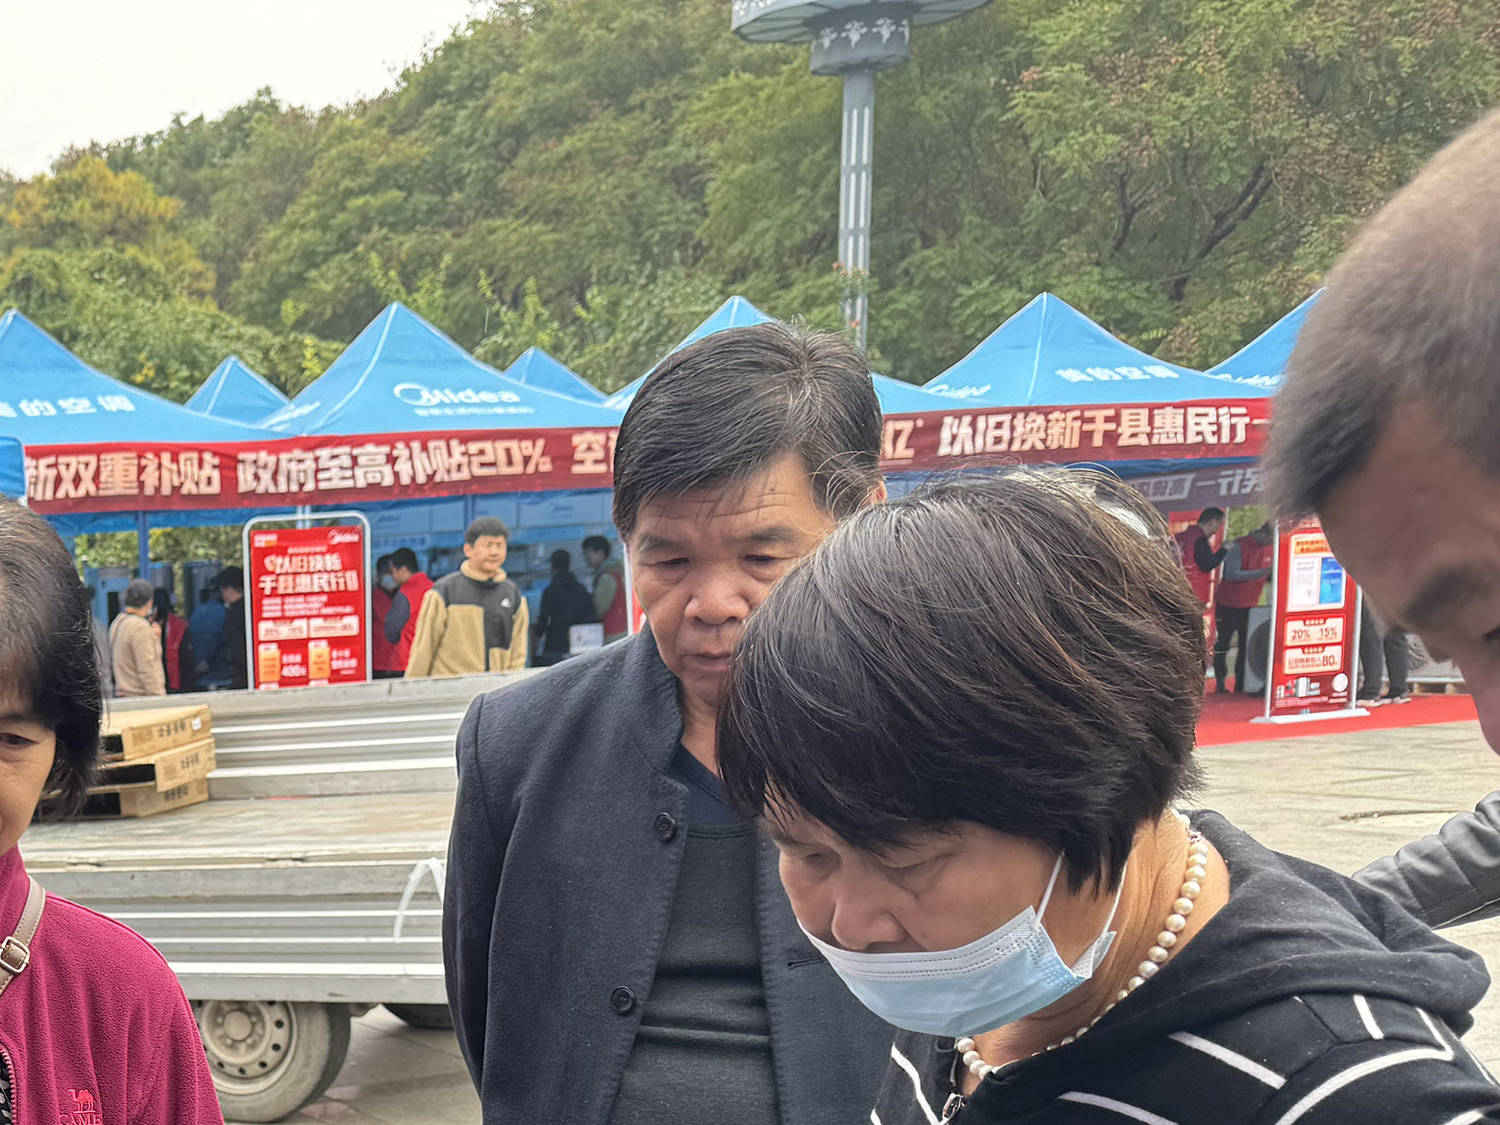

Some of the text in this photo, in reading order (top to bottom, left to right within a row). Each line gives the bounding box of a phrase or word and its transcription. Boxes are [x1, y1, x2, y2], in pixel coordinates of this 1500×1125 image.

[393, 383, 521, 407] Midea
[237, 437, 552, 495] 政府至高补贴20%
[571, 431, 618, 474] 空
